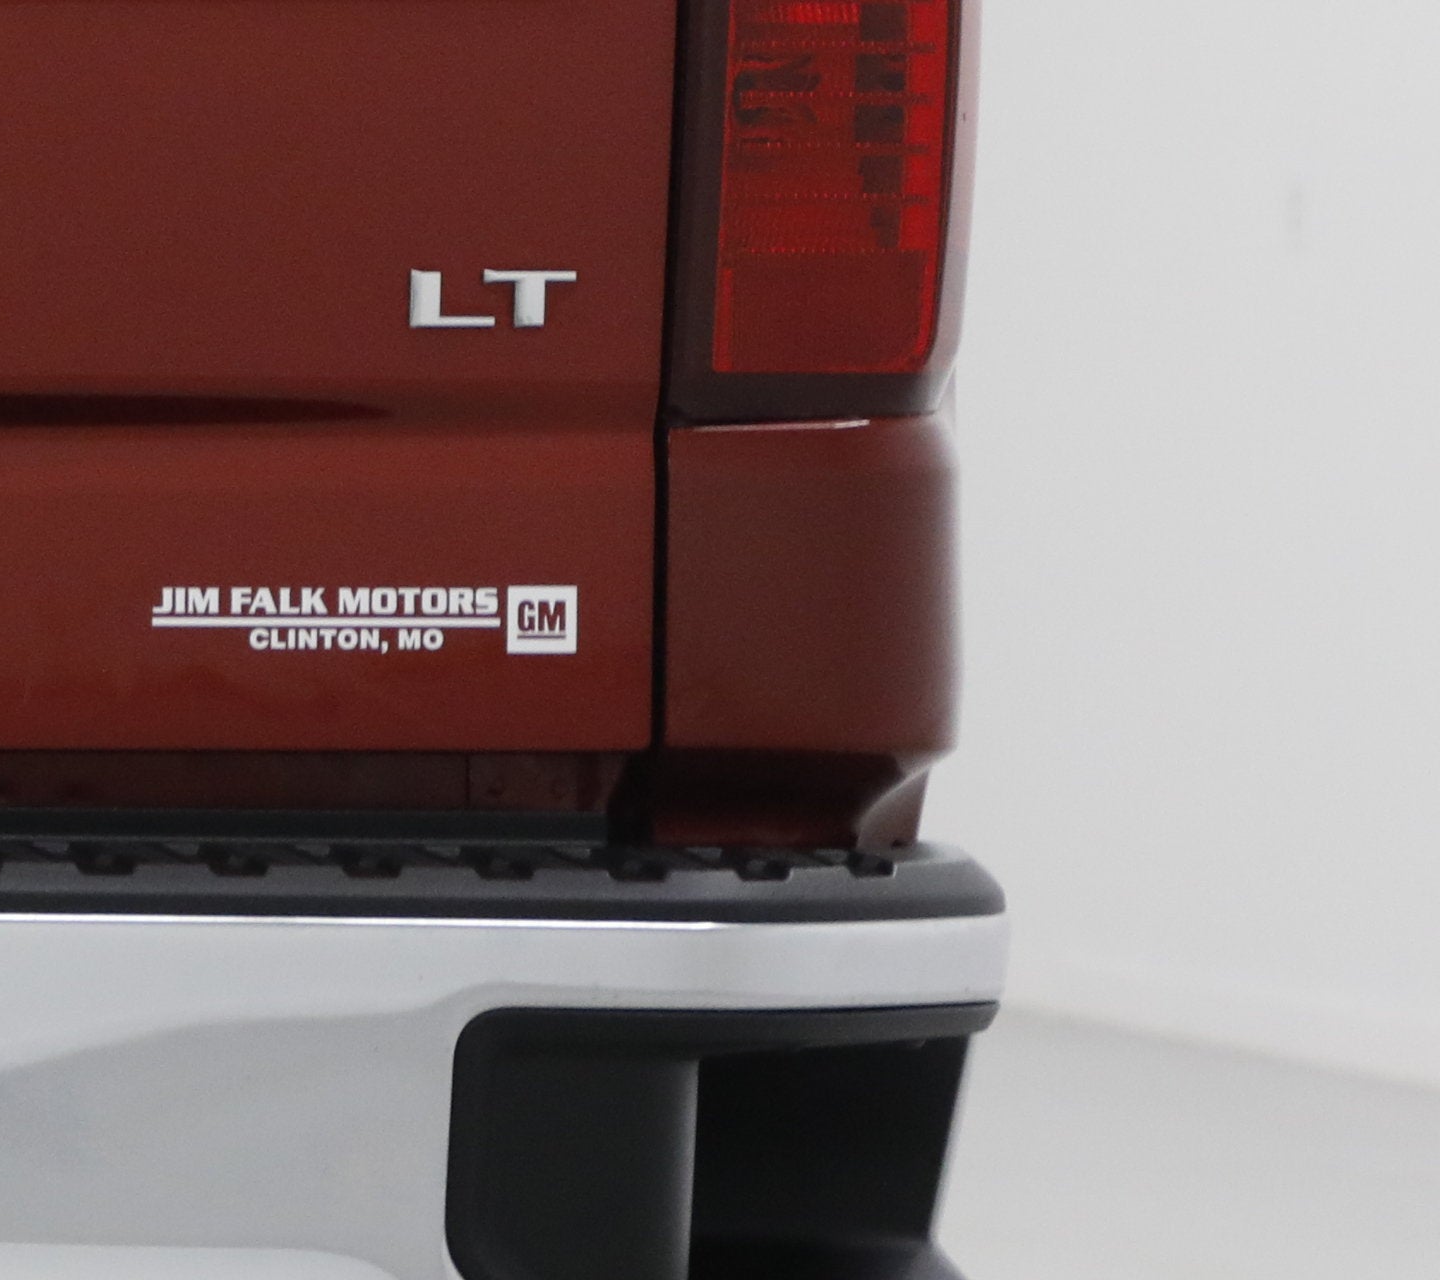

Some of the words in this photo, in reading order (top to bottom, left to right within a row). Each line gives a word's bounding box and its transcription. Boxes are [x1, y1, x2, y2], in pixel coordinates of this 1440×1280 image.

[408, 267, 578, 329] LT
[151, 585, 220, 615] JIM
[229, 585, 328, 615] FALK
[336, 586, 499, 616] MOTORS
[248, 627, 390, 655] CLINTON,
[397, 628, 445, 652] MO
